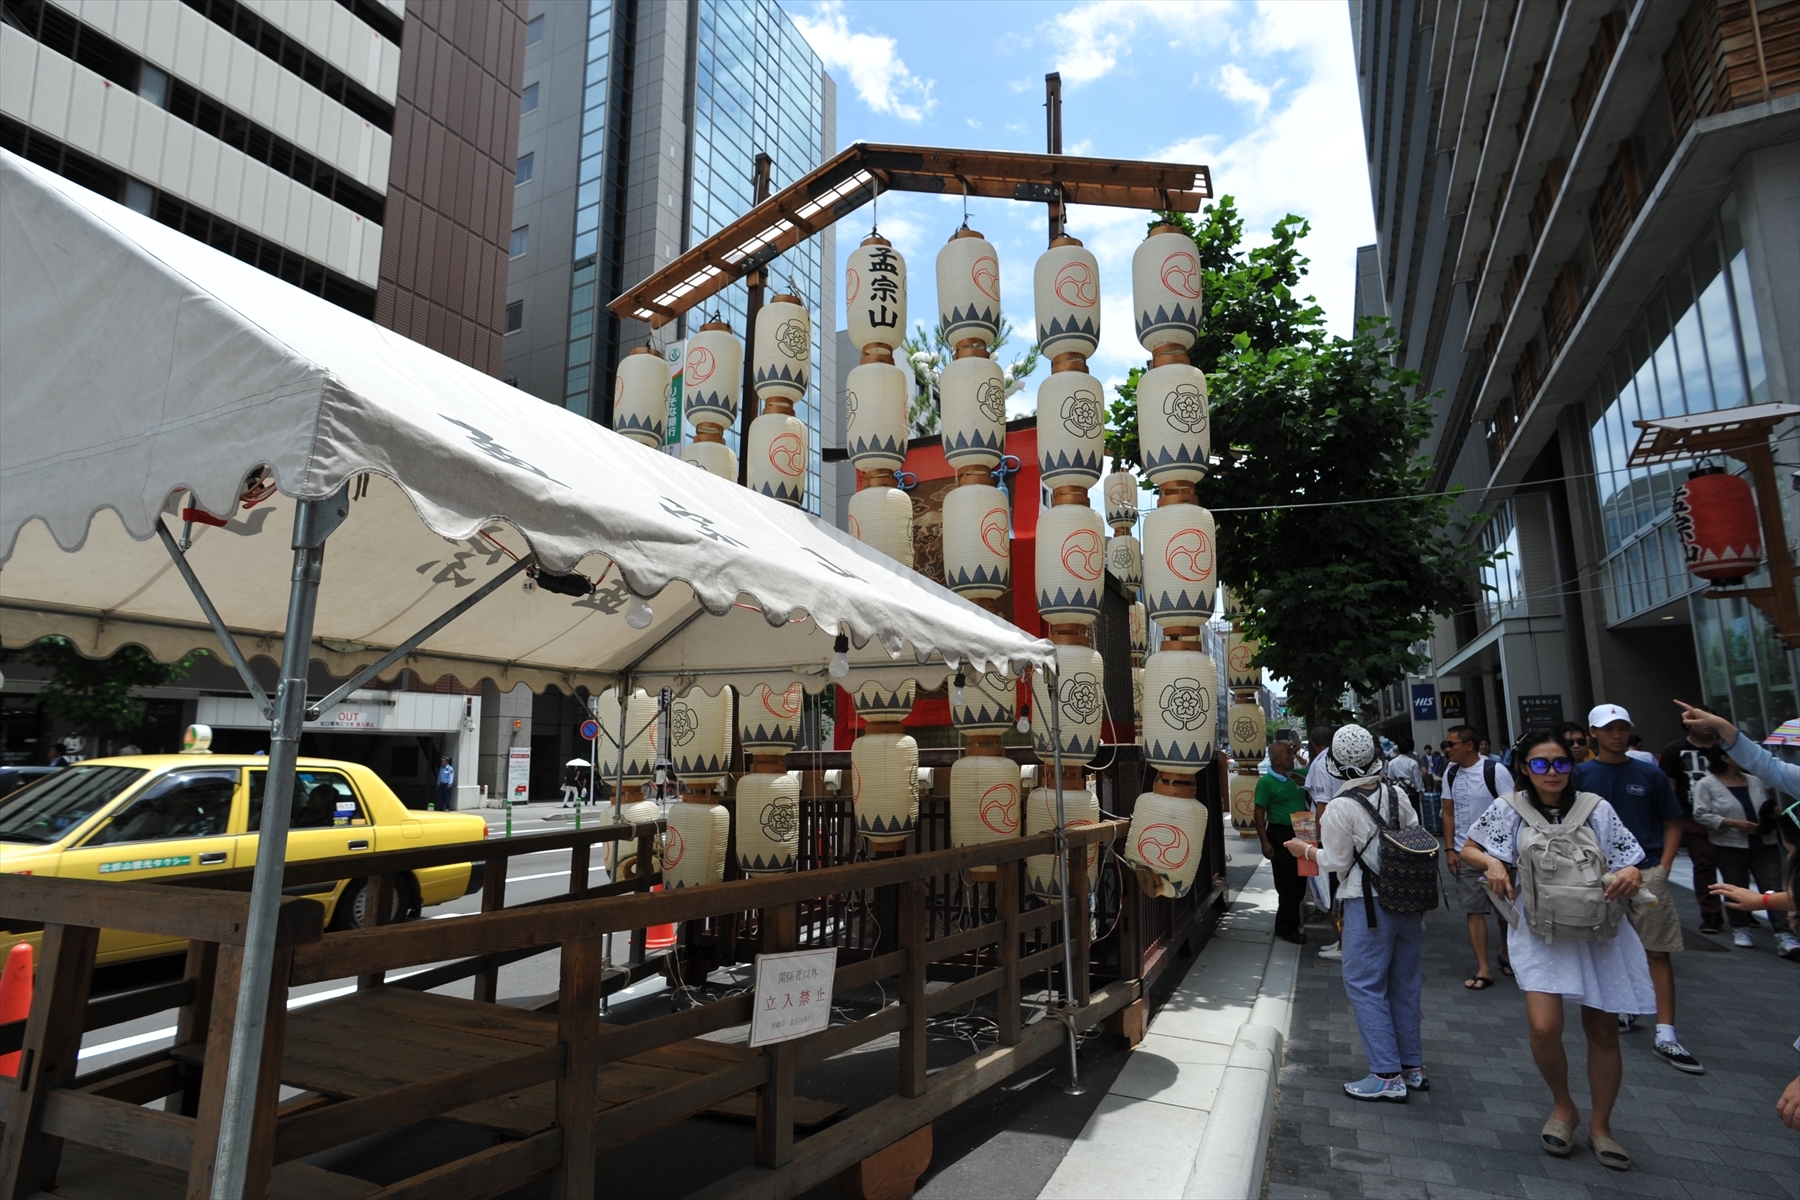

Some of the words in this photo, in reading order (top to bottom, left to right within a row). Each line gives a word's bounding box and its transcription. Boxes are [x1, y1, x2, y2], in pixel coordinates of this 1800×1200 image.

[867, 246, 899, 329] 孟宗山
[337, 711, 359, 721] OUT
[778, 967, 818, 985] 関係者以外
[763, 987, 826, 1012] 立入禁止
